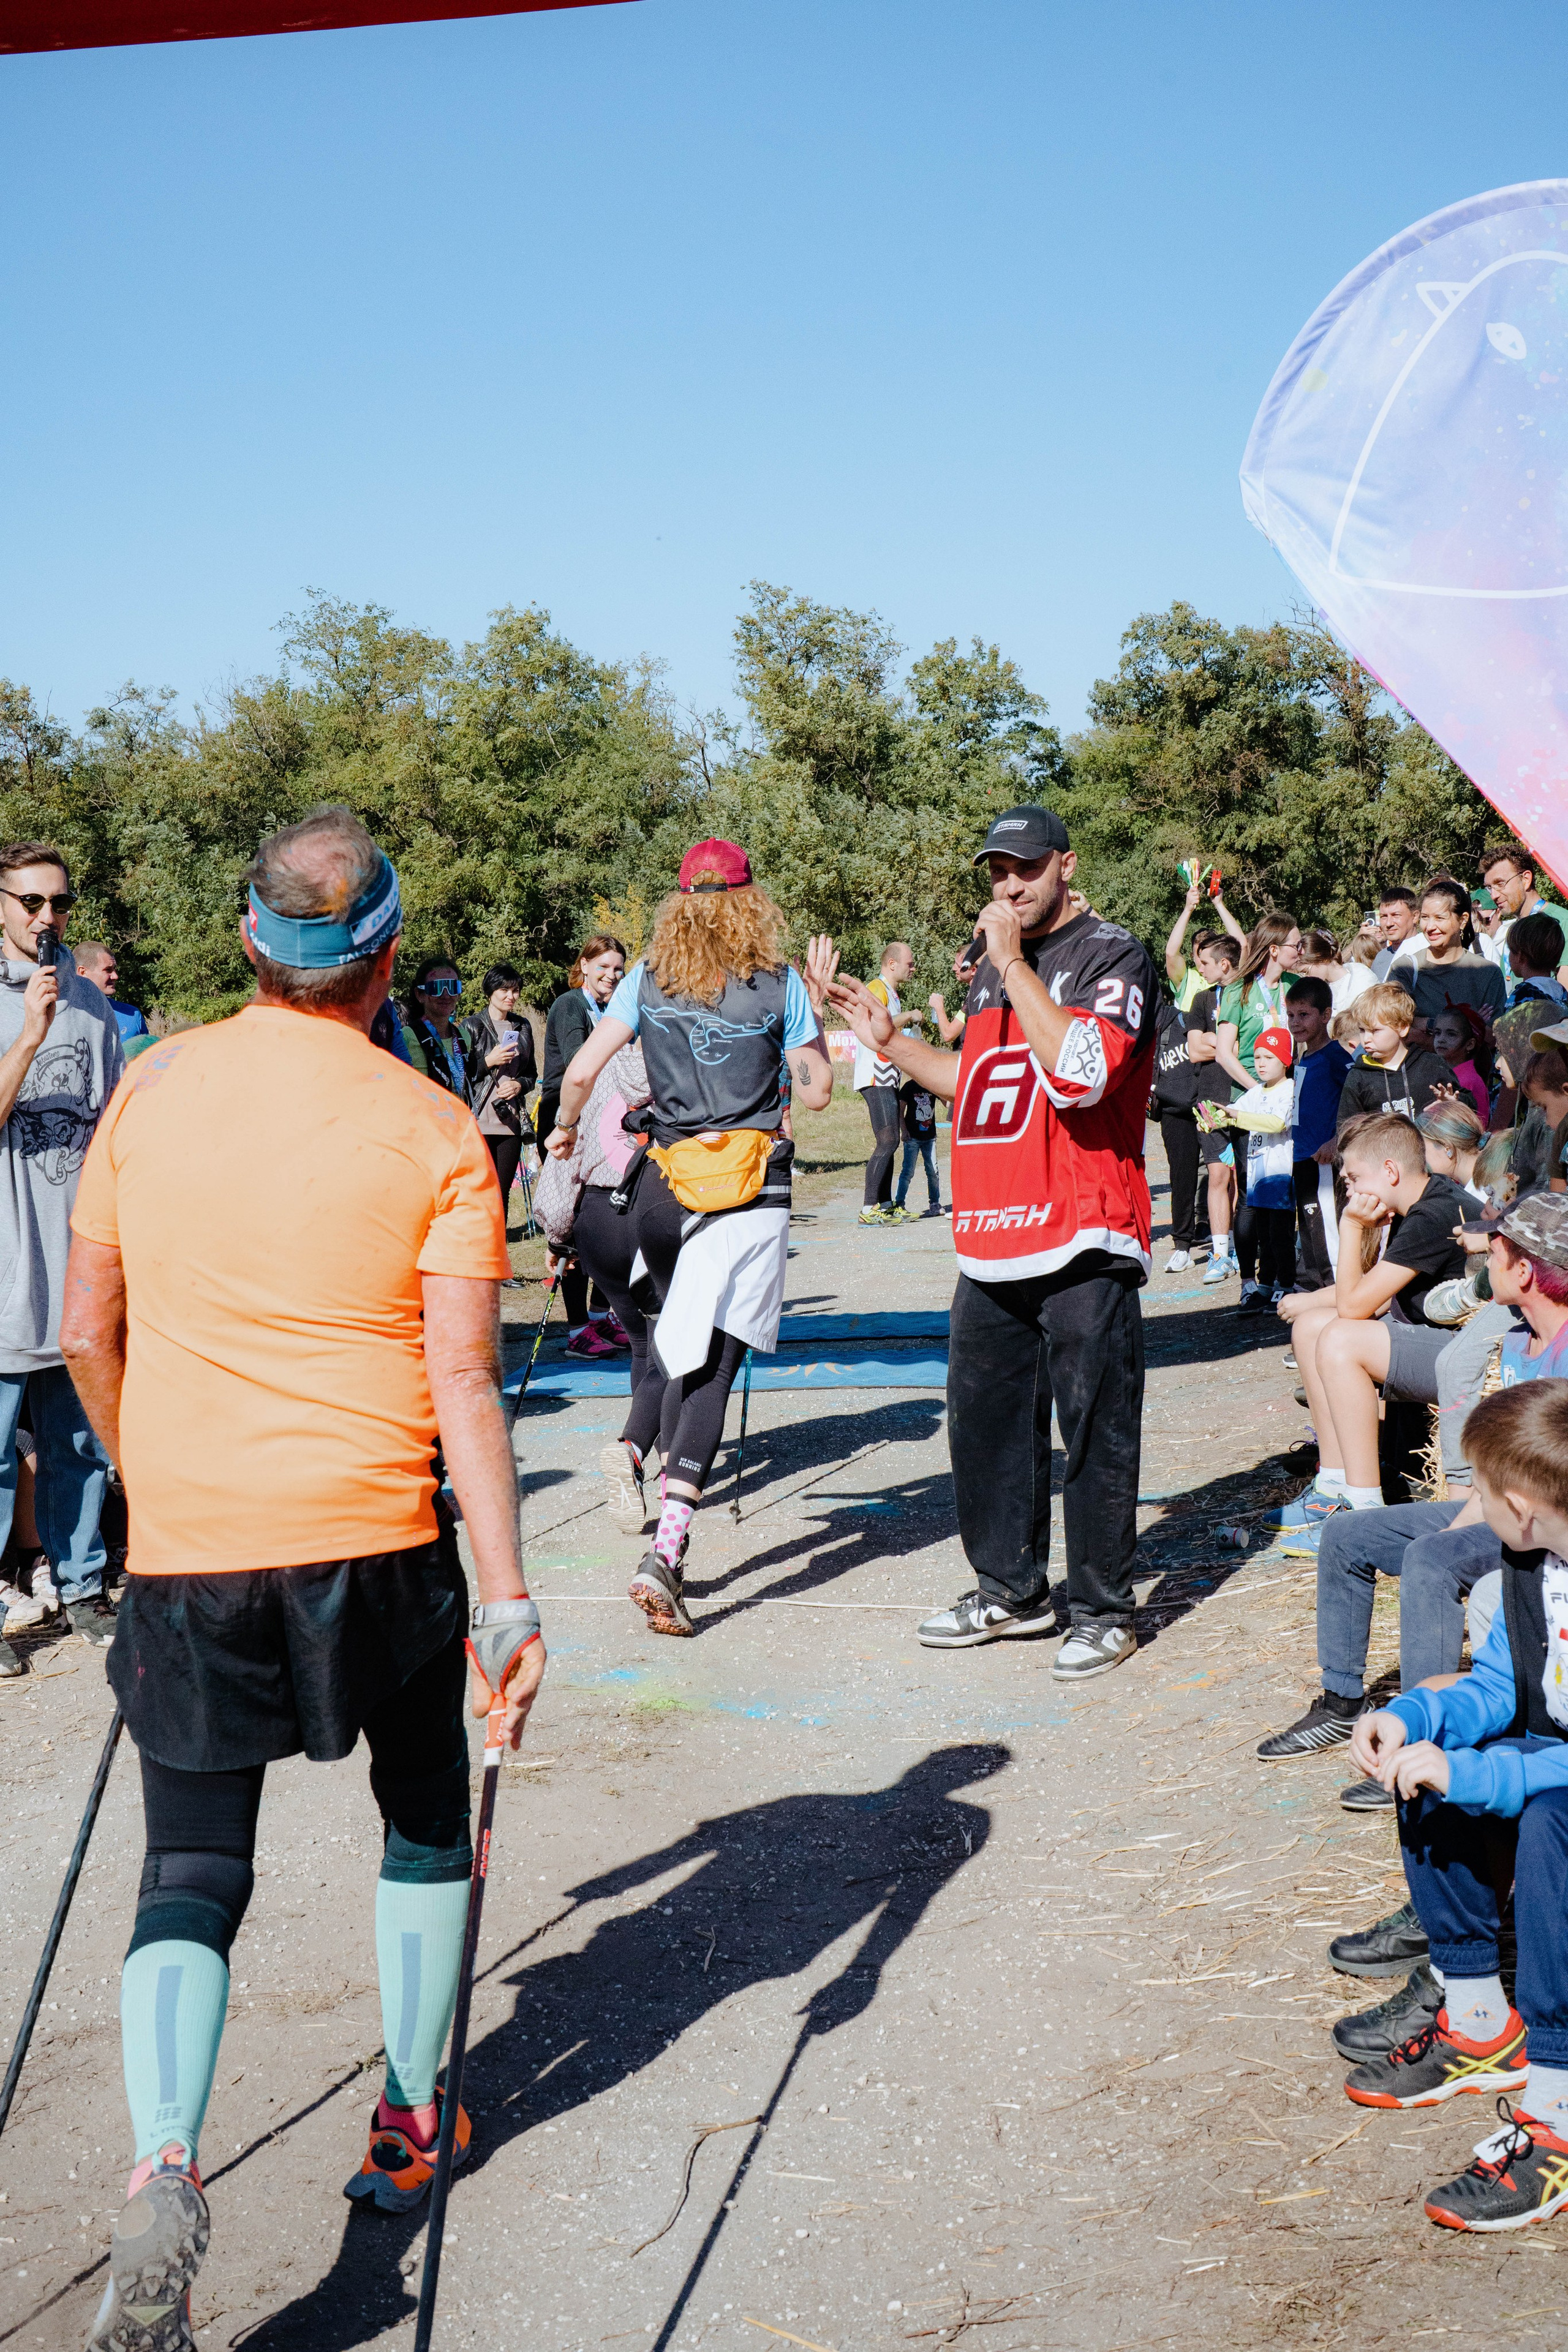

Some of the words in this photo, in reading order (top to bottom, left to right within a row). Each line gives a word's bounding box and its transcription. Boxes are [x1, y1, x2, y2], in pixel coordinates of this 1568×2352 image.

[1095, 978, 1144, 1030] 26
[448, 1052, 460, 1087] KRASILNIK
[1060, 1044, 1072, 1072] РОССИИ
[678, 1460, 701, 1472] RUNNING
